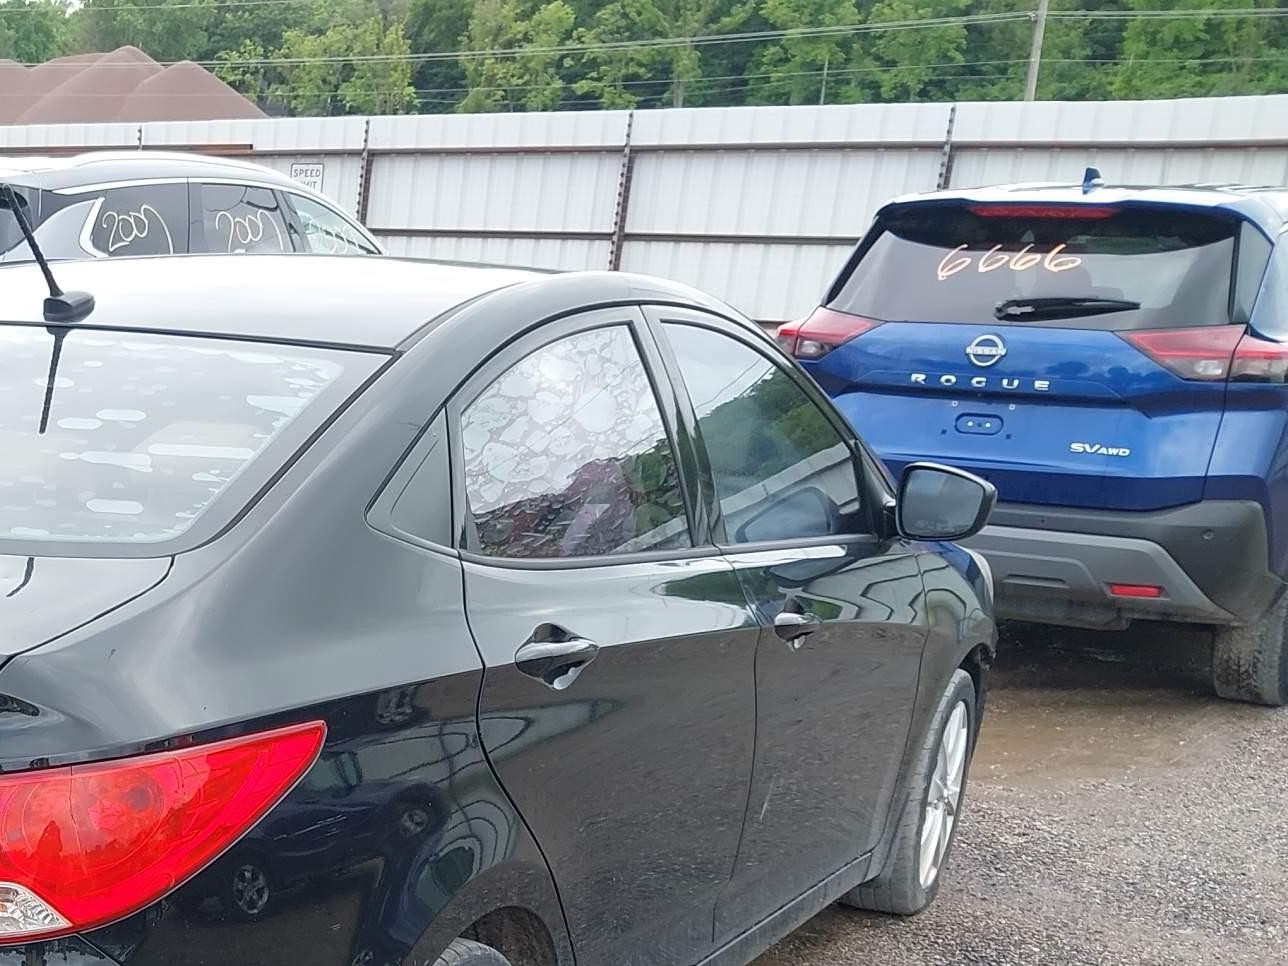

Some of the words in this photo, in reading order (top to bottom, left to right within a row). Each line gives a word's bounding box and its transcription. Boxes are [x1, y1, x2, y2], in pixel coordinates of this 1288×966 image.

[293, 168, 321, 178] SPEED
[102, 204, 174, 254] 2007
[215, 209, 284, 254] 2007
[937, 243, 1082, 281] 6666
[910, 373, 1050, 391] ROGUE
